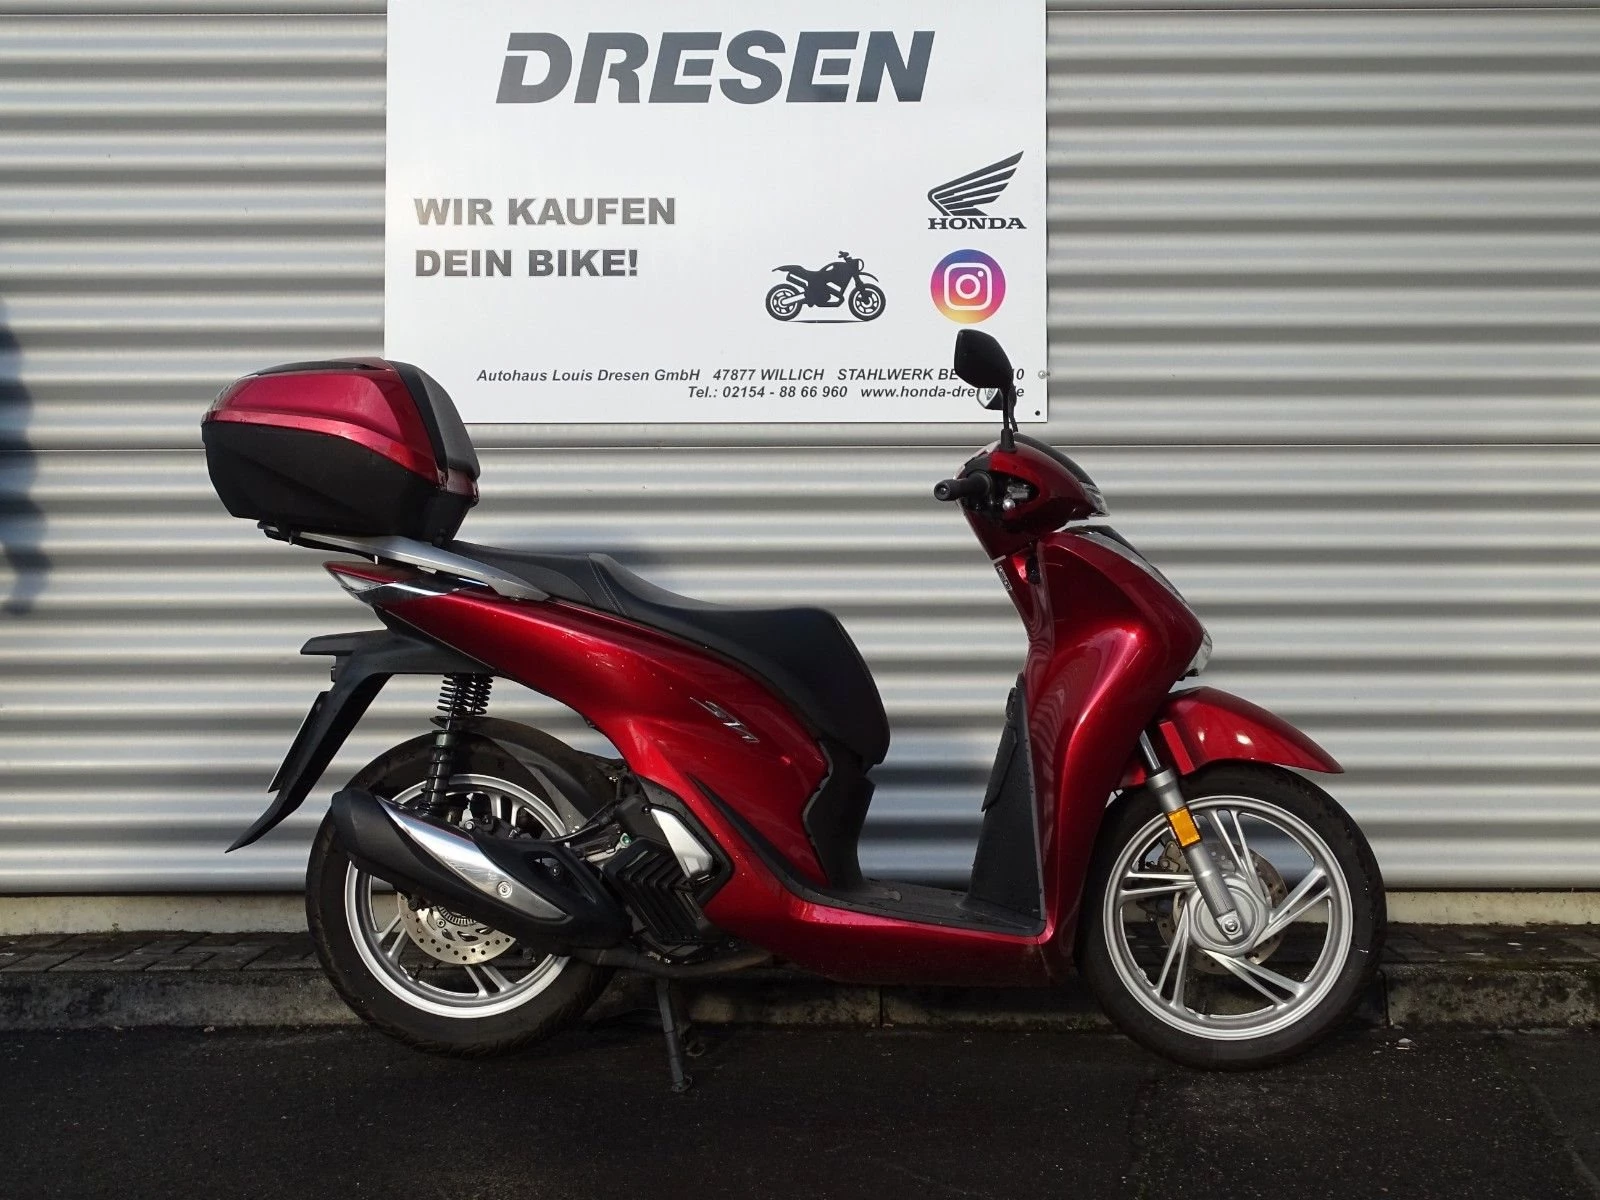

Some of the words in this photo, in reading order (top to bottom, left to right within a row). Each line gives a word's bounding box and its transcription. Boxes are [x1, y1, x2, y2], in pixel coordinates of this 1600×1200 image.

[496, 30, 935, 104] DRESEN
[415, 198, 493, 226] WIR
[509, 198, 676, 226] KAUFEN
[927, 217, 1027, 230] HONDA
[415, 250, 511, 276] DEIN
[528, 250, 638, 277] BIKE!
[477, 369, 547, 382] Autohaus
[552, 369, 593, 382] Louis
[597, 369, 650, 382] Dresen
[654, 369, 701, 382] GmbH
[712, 368, 757, 381] 47877
[761, 368, 825, 381] WILLICH
[837, 368, 934, 381] STAHLWERK
[688, 385, 718, 398] Tel.:
[722, 385, 766, 398] 02154
[779, 385, 797, 398] 88
[800, 385, 818, 398] 66
[822, 385, 848, 398] 960
